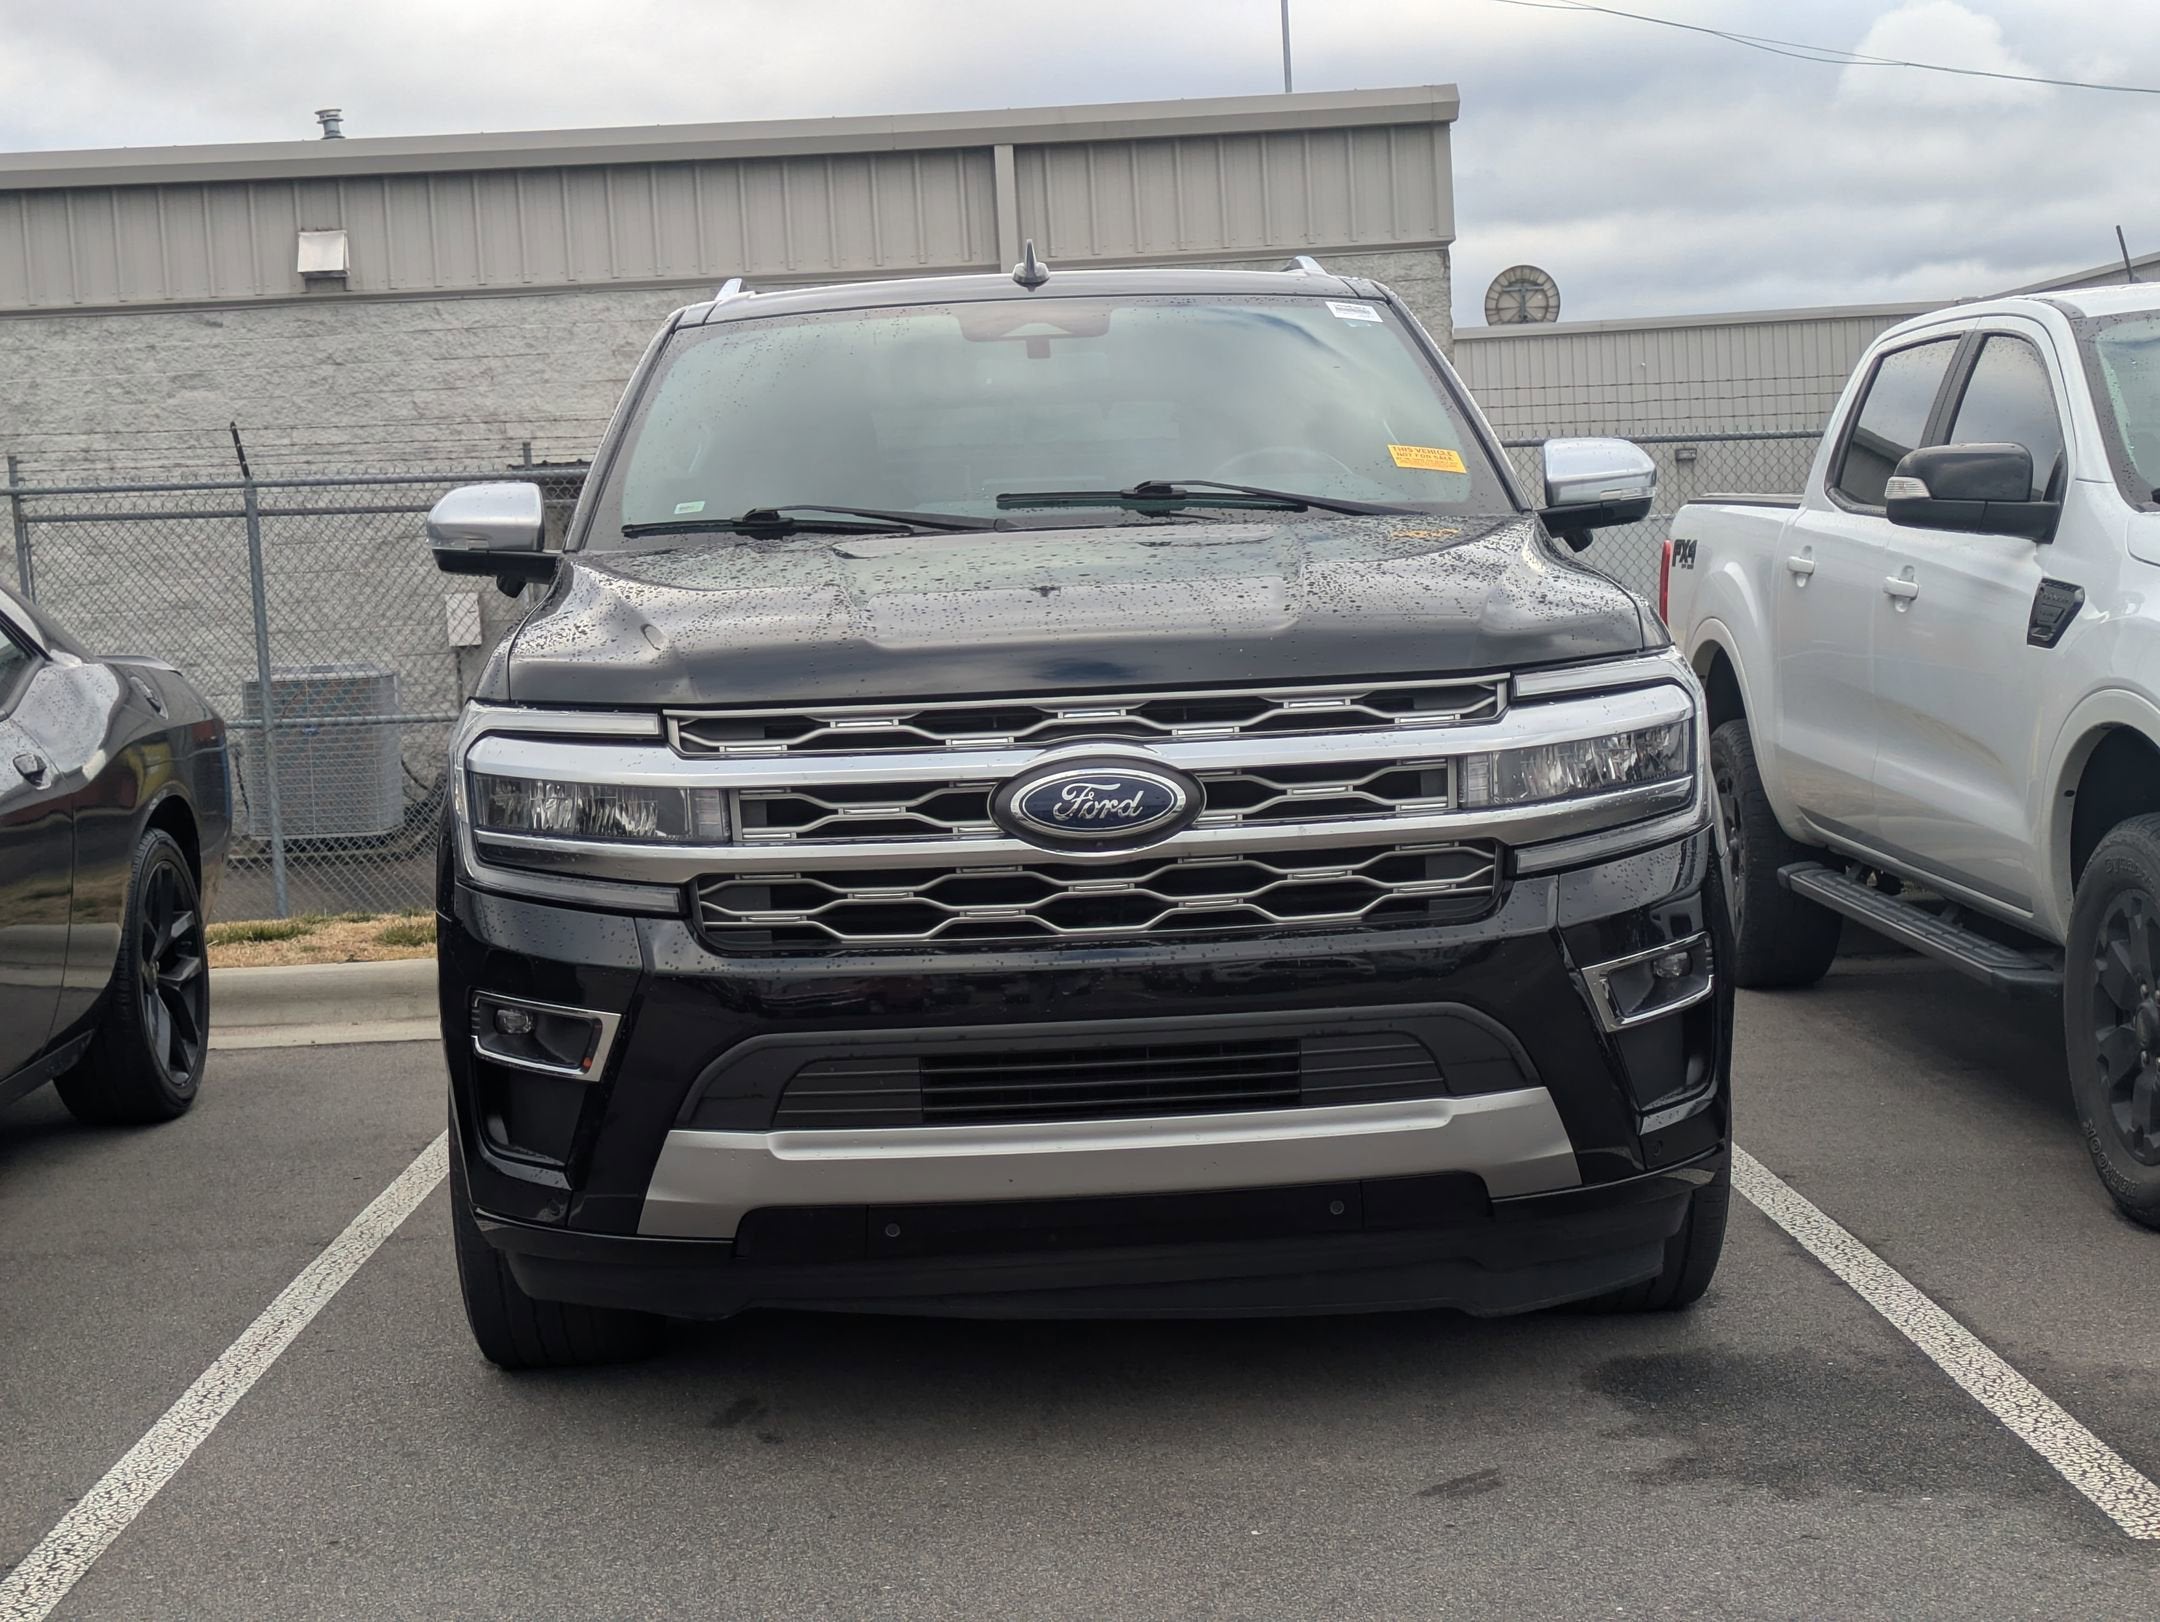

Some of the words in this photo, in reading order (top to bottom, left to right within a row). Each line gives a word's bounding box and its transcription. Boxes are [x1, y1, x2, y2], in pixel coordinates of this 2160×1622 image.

[1392, 445, 1414, 453] THIS
[1415, 447, 1454, 457] VEHICLE
[1052, 782, 1145, 821] Ford
